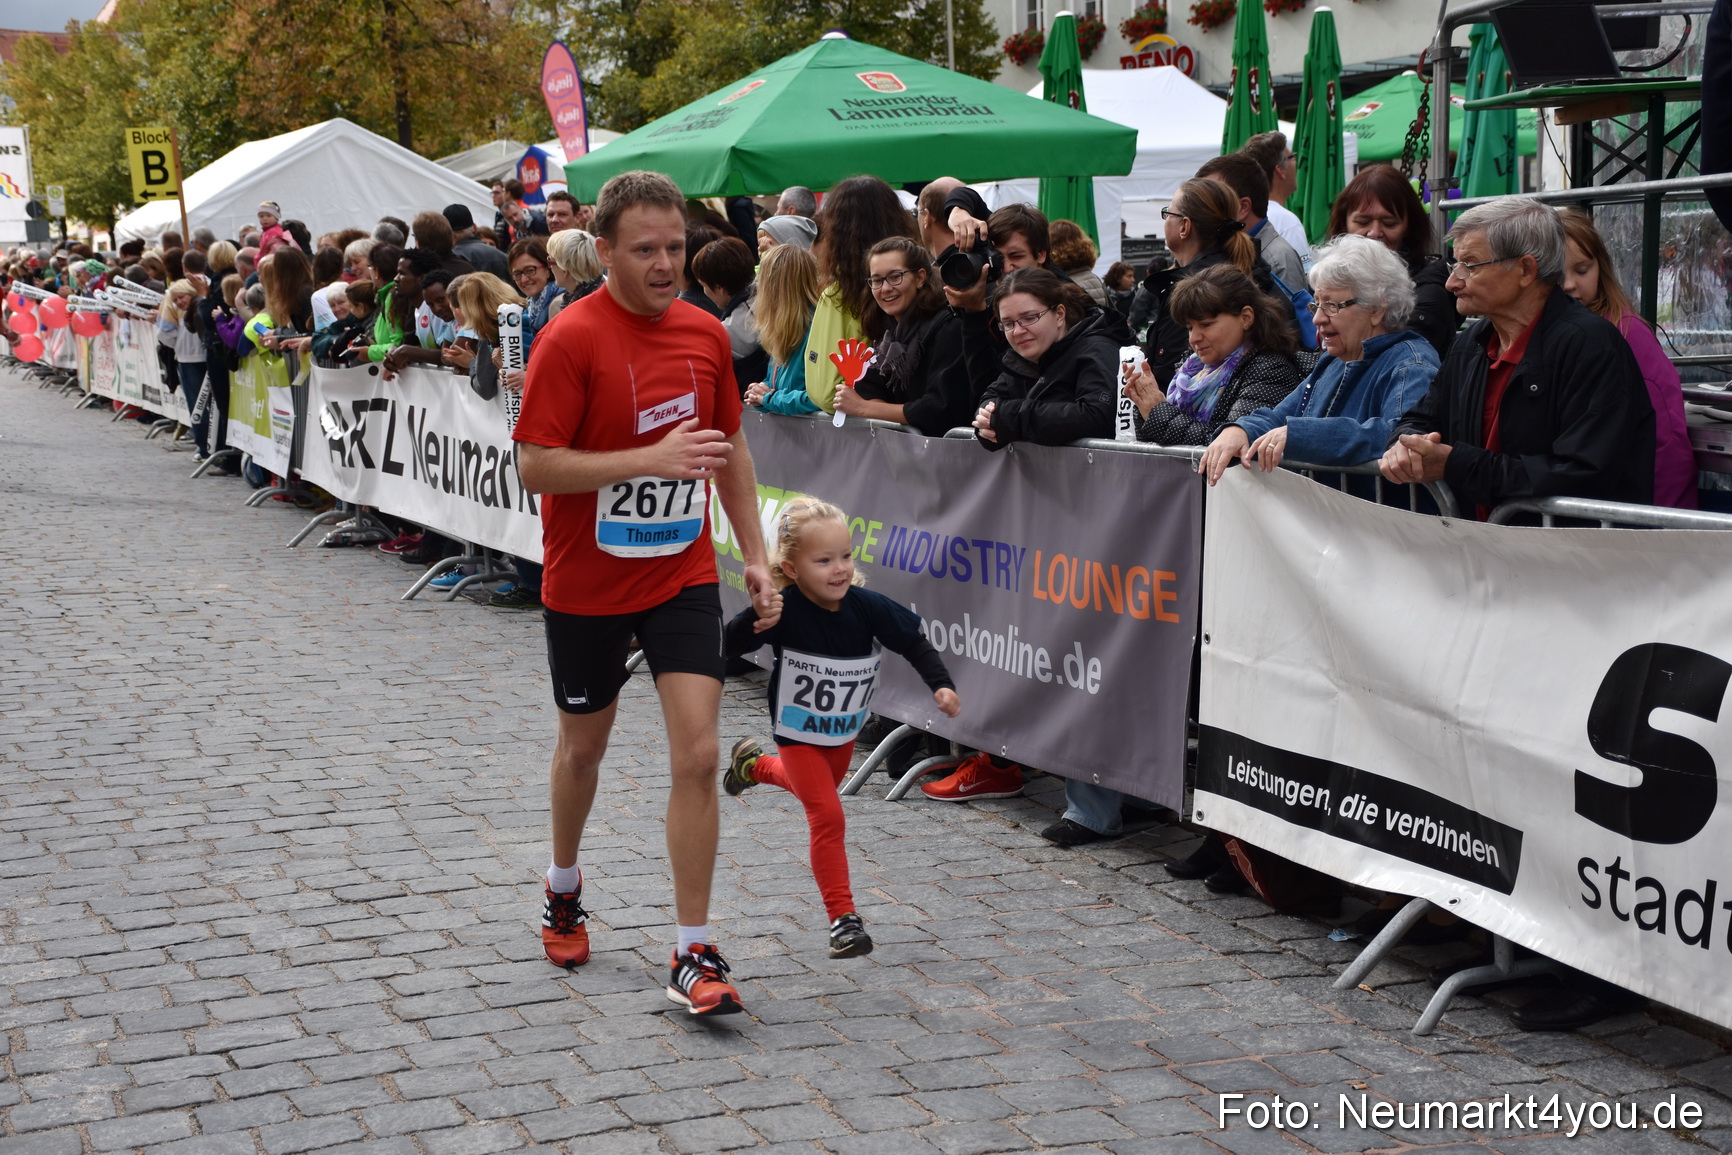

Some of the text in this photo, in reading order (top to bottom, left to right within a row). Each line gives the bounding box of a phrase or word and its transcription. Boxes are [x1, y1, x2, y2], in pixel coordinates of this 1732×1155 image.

[842, 94, 959, 108] Neumarkter
[827, 103, 995, 121] Lammsbräu
[132, 130, 172, 144] Block
[142, 150, 169, 186] B
[508, 336, 521, 369] BMW
[653, 404, 679, 422] DEHN
[610, 479, 697, 519] 2677
[626, 528, 680, 543] Thomas
[845, 514, 884, 564] CE
[882, 525, 1026, 593] INDUSTRY
[1033, 550, 1180, 624] LOUNGE
[788, 658, 873, 677] PARTL Neumarkt
[802, 715, 857, 735] ANNA
[1227, 755, 1500, 868] Leistungen, die verbinden
